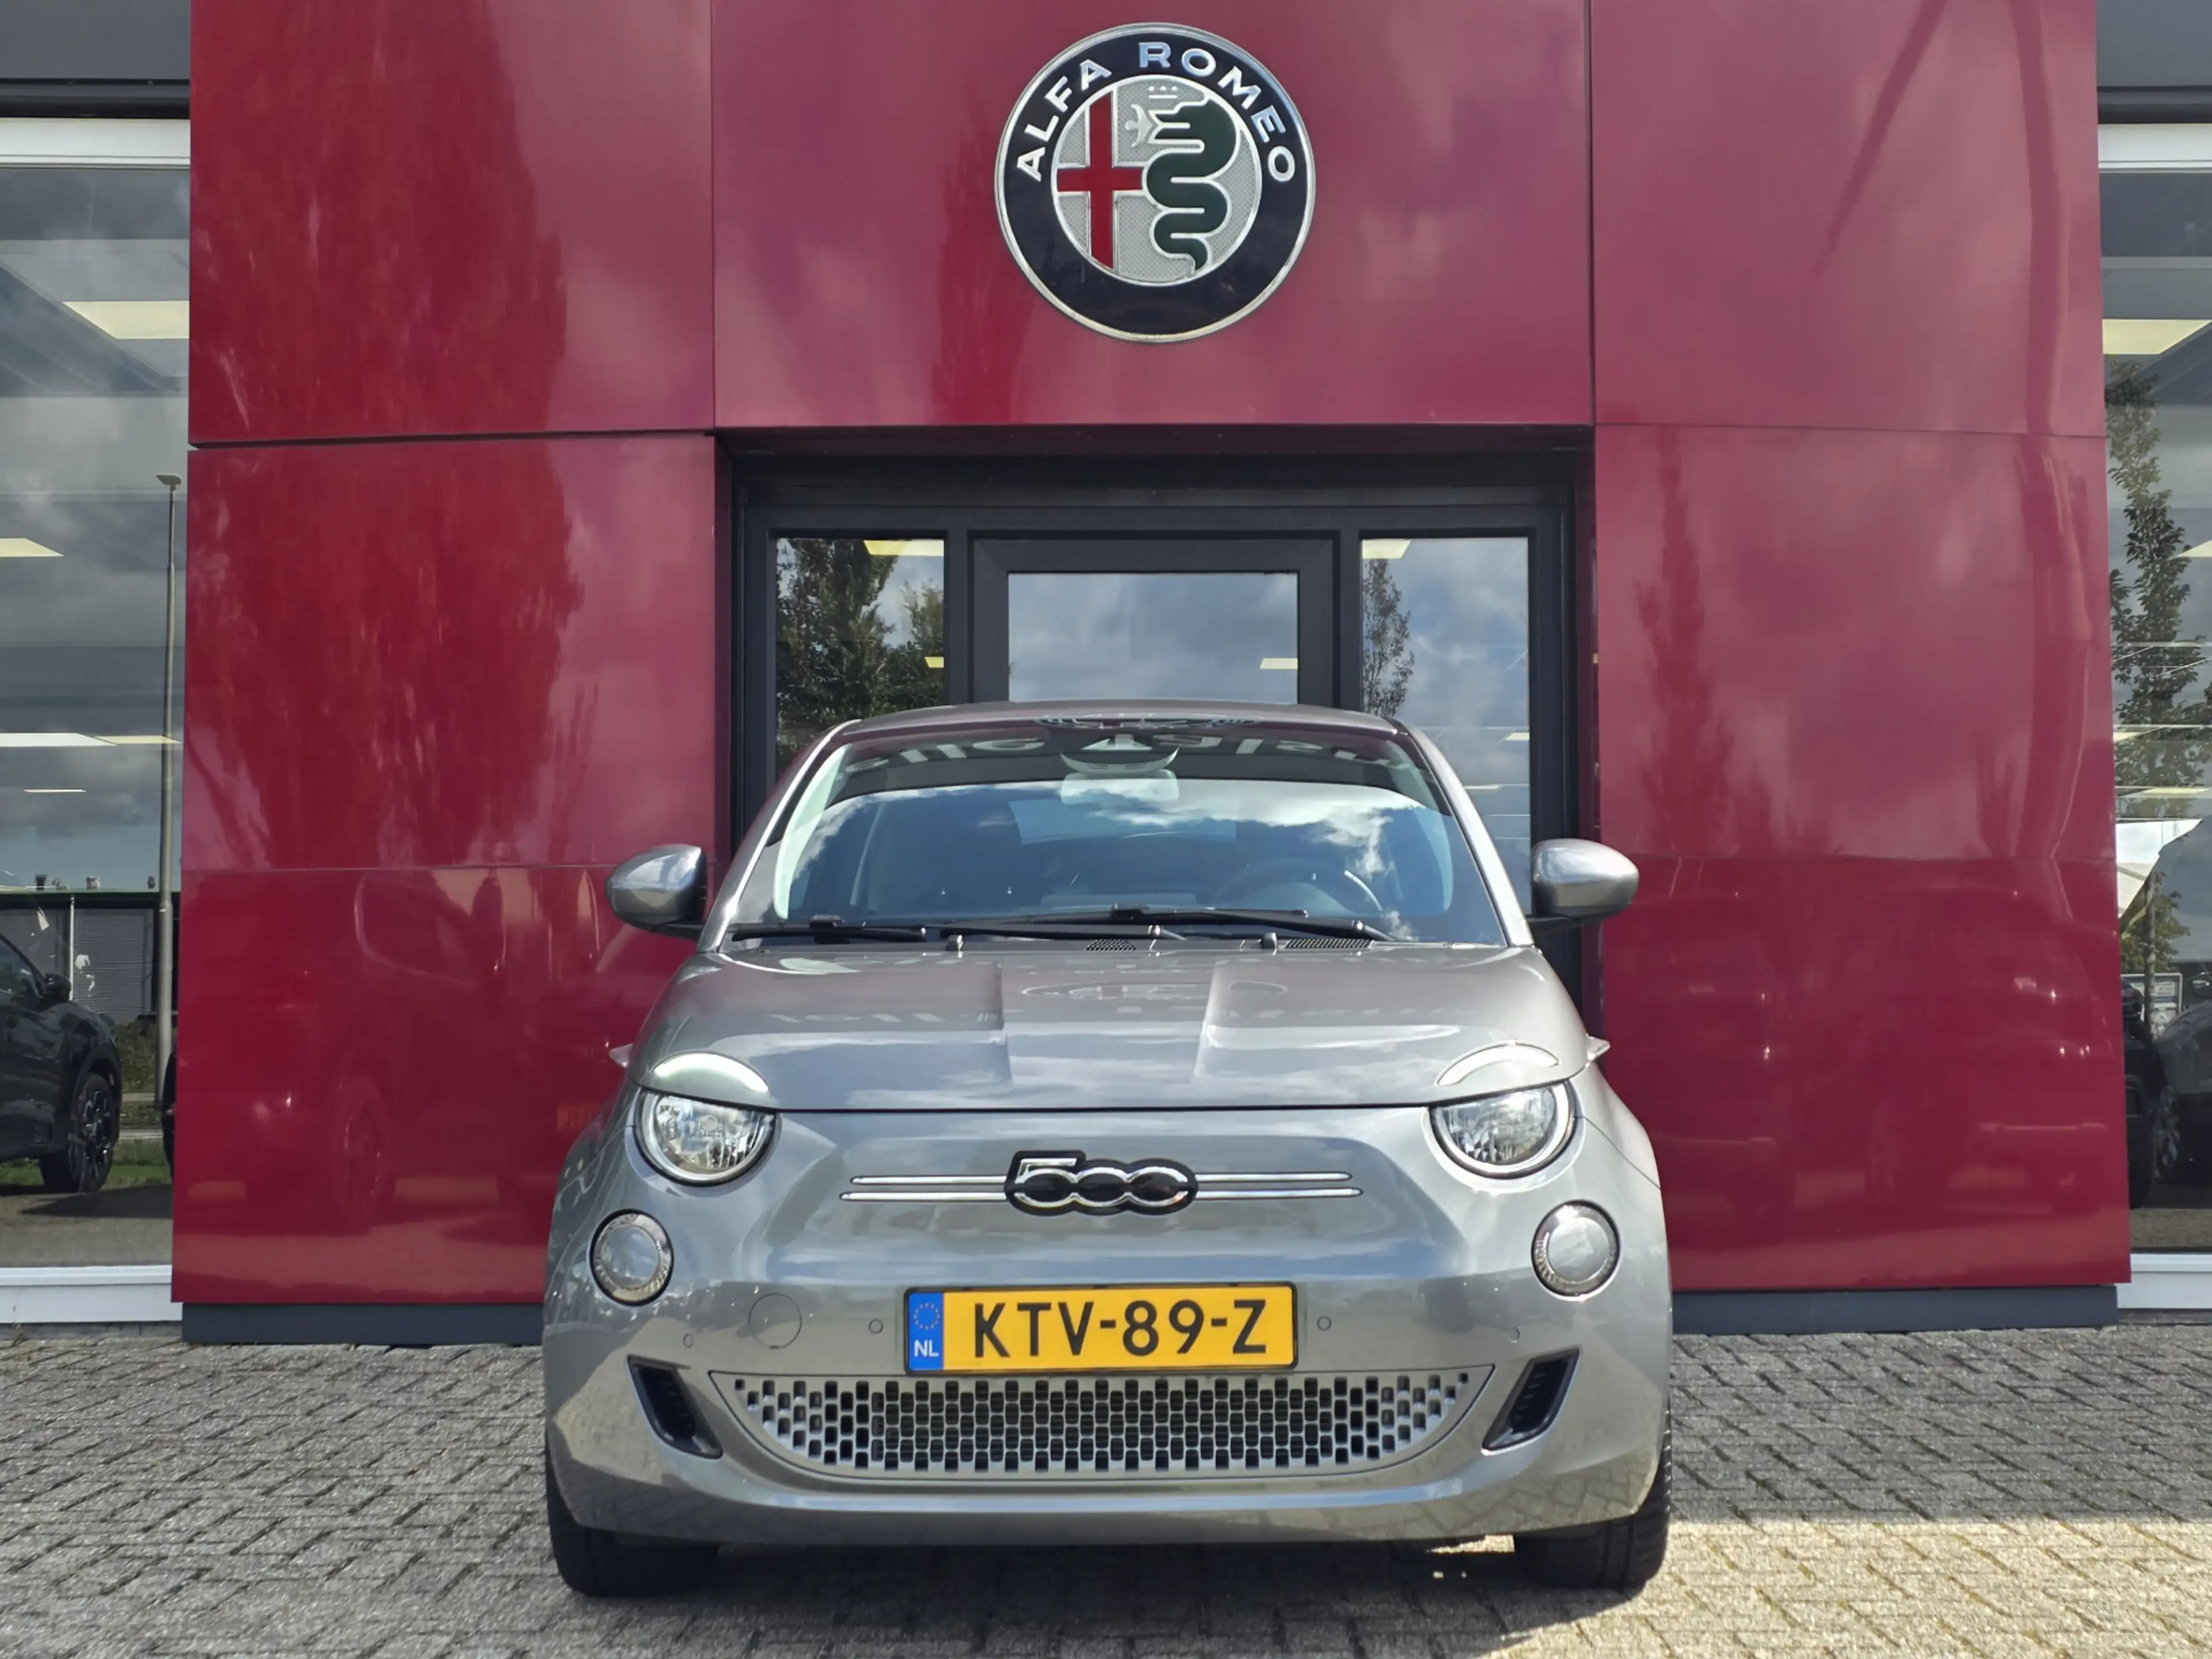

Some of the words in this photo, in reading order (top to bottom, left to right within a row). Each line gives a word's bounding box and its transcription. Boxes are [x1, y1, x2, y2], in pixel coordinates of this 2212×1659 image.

[1017, 58, 1112, 181] ALFA
[1138, 41, 1296, 183] ROMEO
[1009, 1154, 1194, 1212] 500
[914, 1339, 940, 1358] NL
[974, 1299, 1267, 1358] KTV-89-Z
